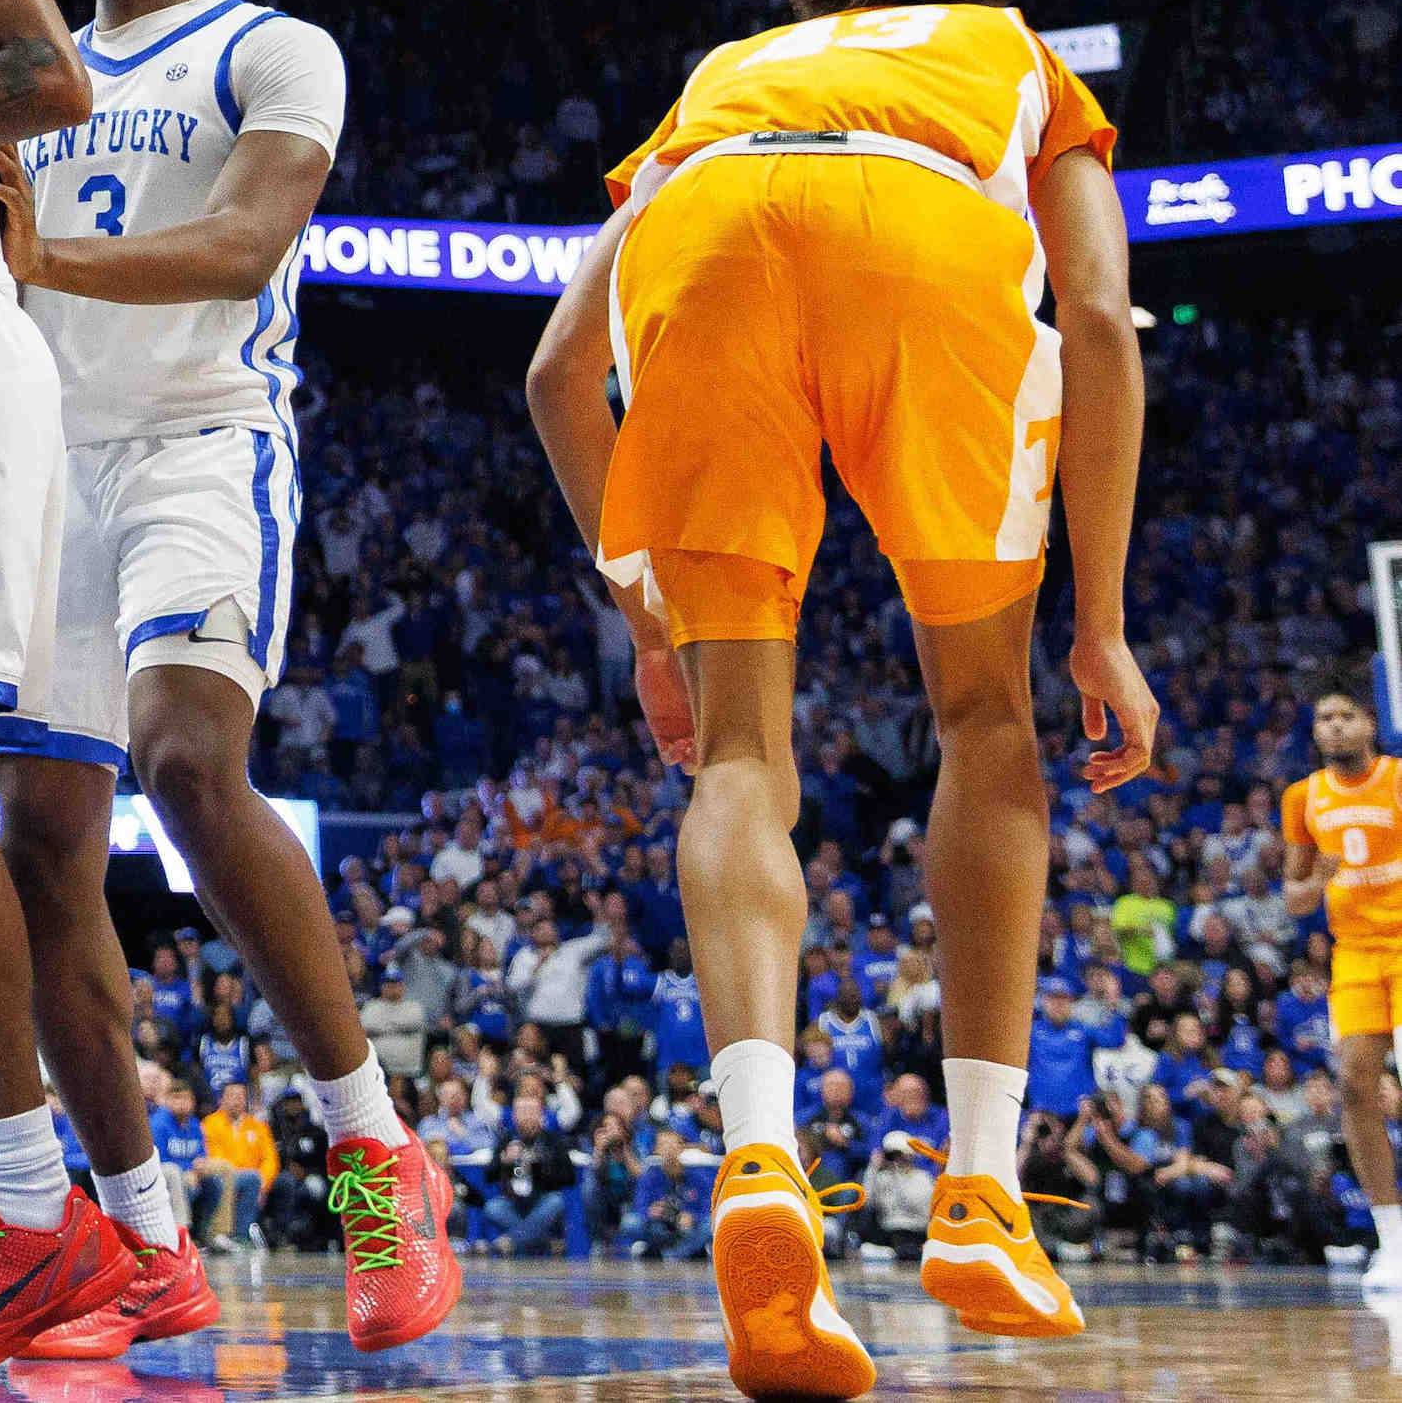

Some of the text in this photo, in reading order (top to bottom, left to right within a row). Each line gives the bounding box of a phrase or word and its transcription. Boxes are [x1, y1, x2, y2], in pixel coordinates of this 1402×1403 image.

[77, 174, 127, 237] 3
[1283, 152, 1402, 215] PHO
[299, 223, 596, 286] HONE DOW
